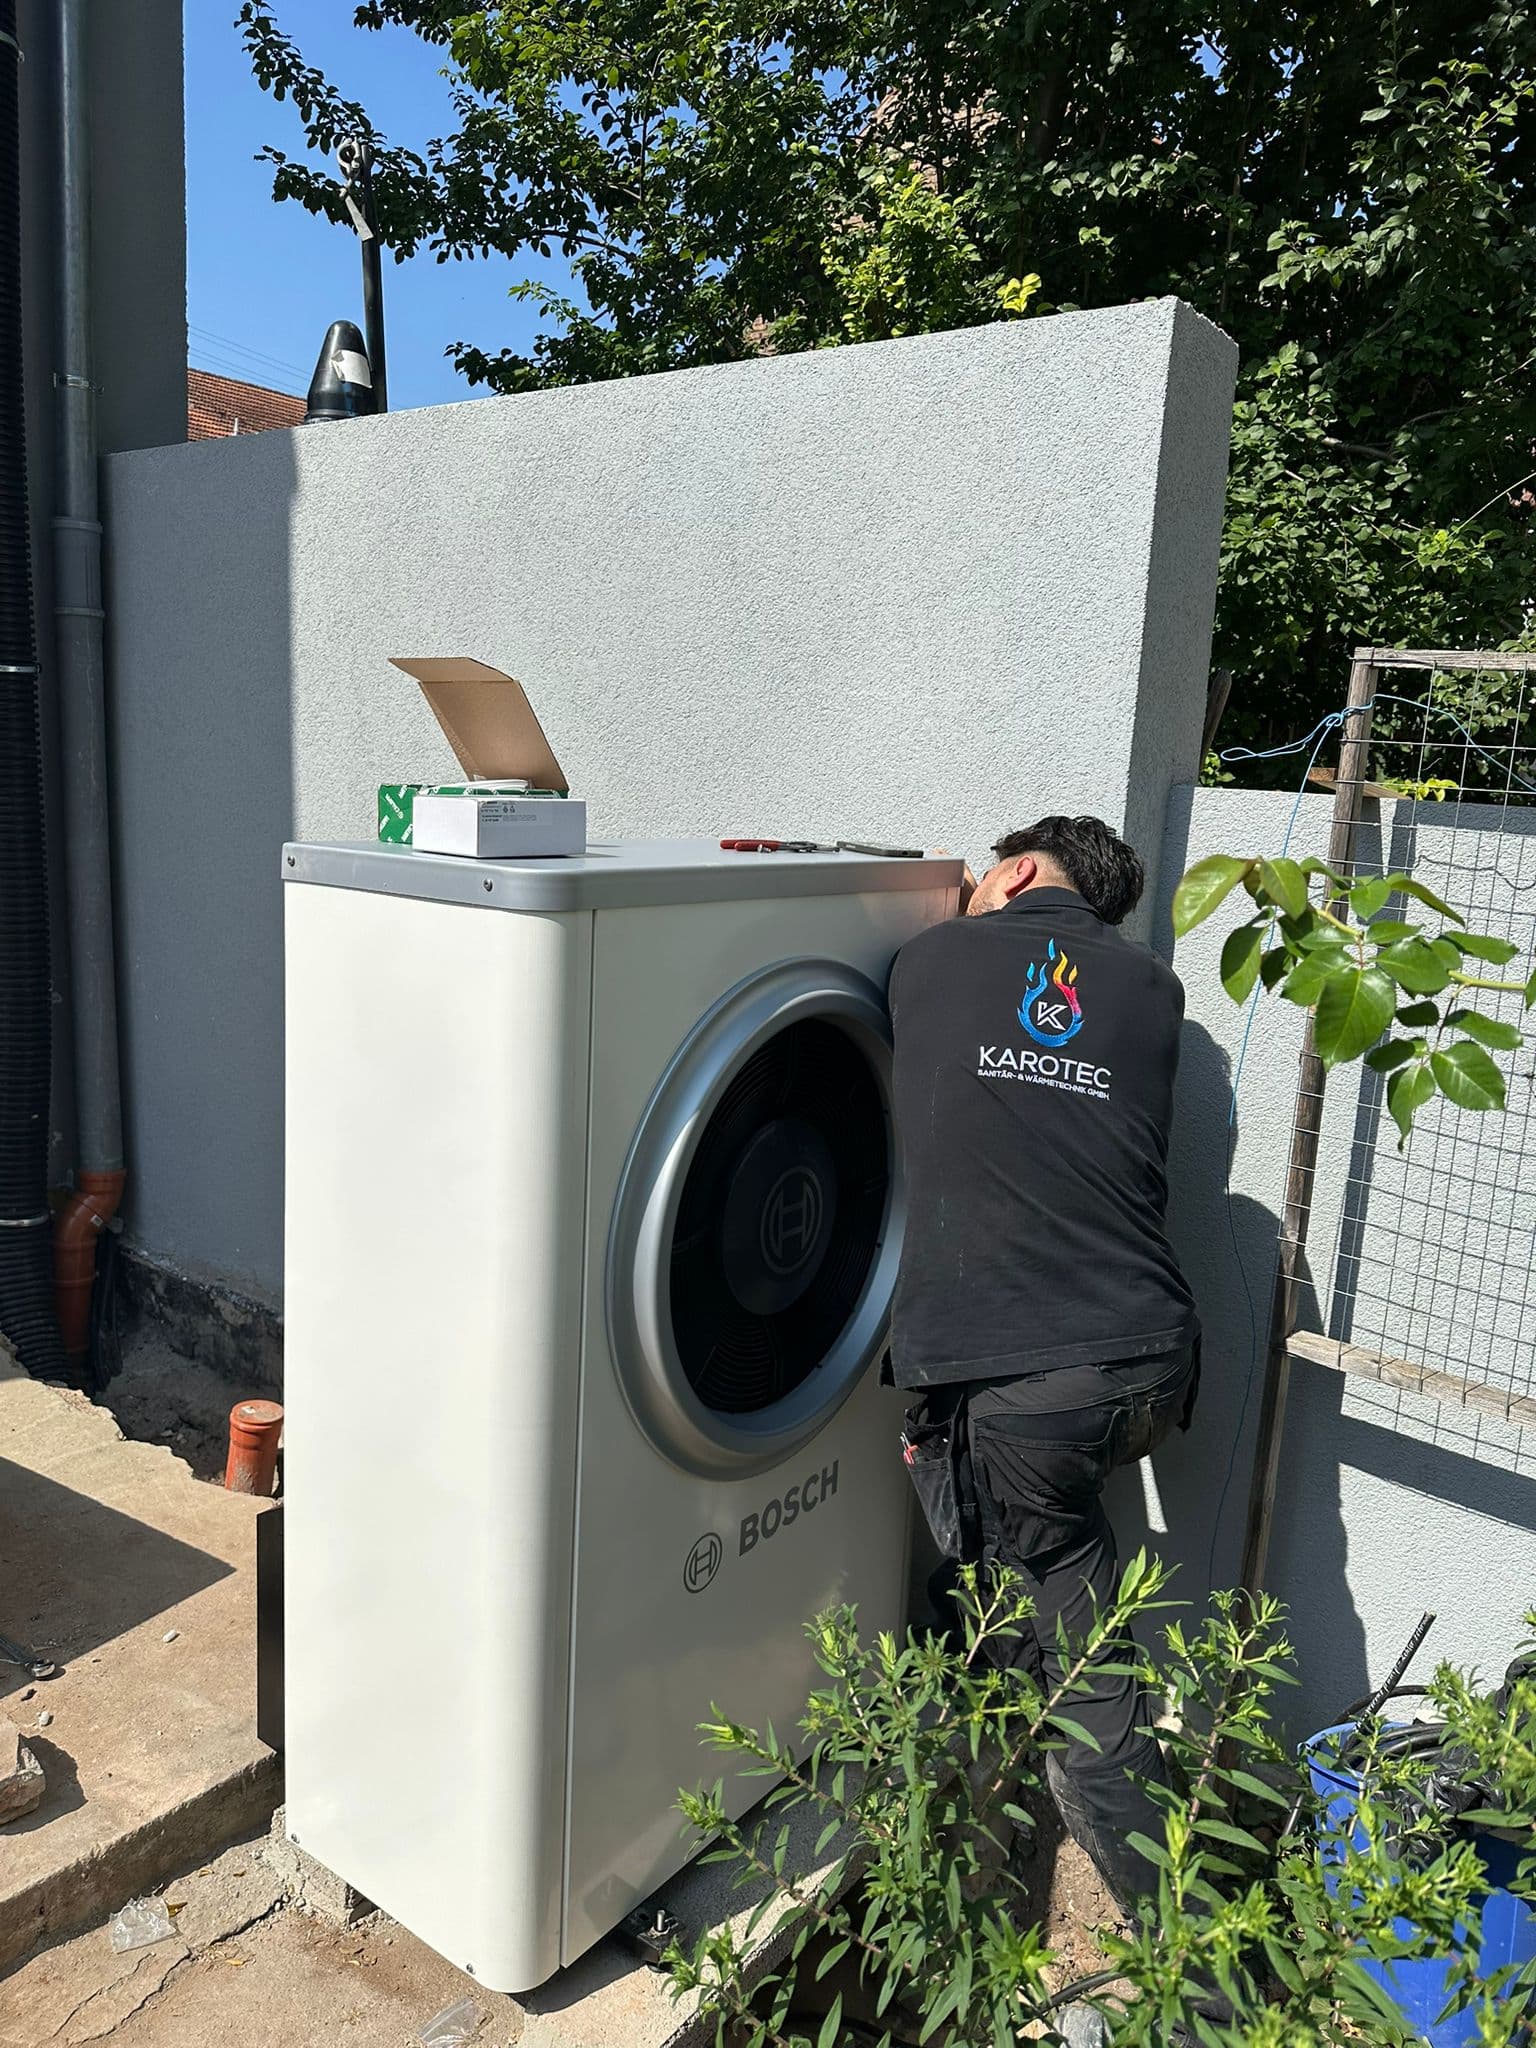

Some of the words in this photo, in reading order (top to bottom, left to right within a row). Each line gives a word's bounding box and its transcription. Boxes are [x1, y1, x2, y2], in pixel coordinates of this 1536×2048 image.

[1036, 1001, 1069, 1031] K
[978, 1045, 1112, 1089] KAROTEC
[1017, 1074, 1025, 1082] &
[1024, 1073, 1087, 1095] WÄRMETECHNIK
[739, 1459, 840, 1557] BOSCH
